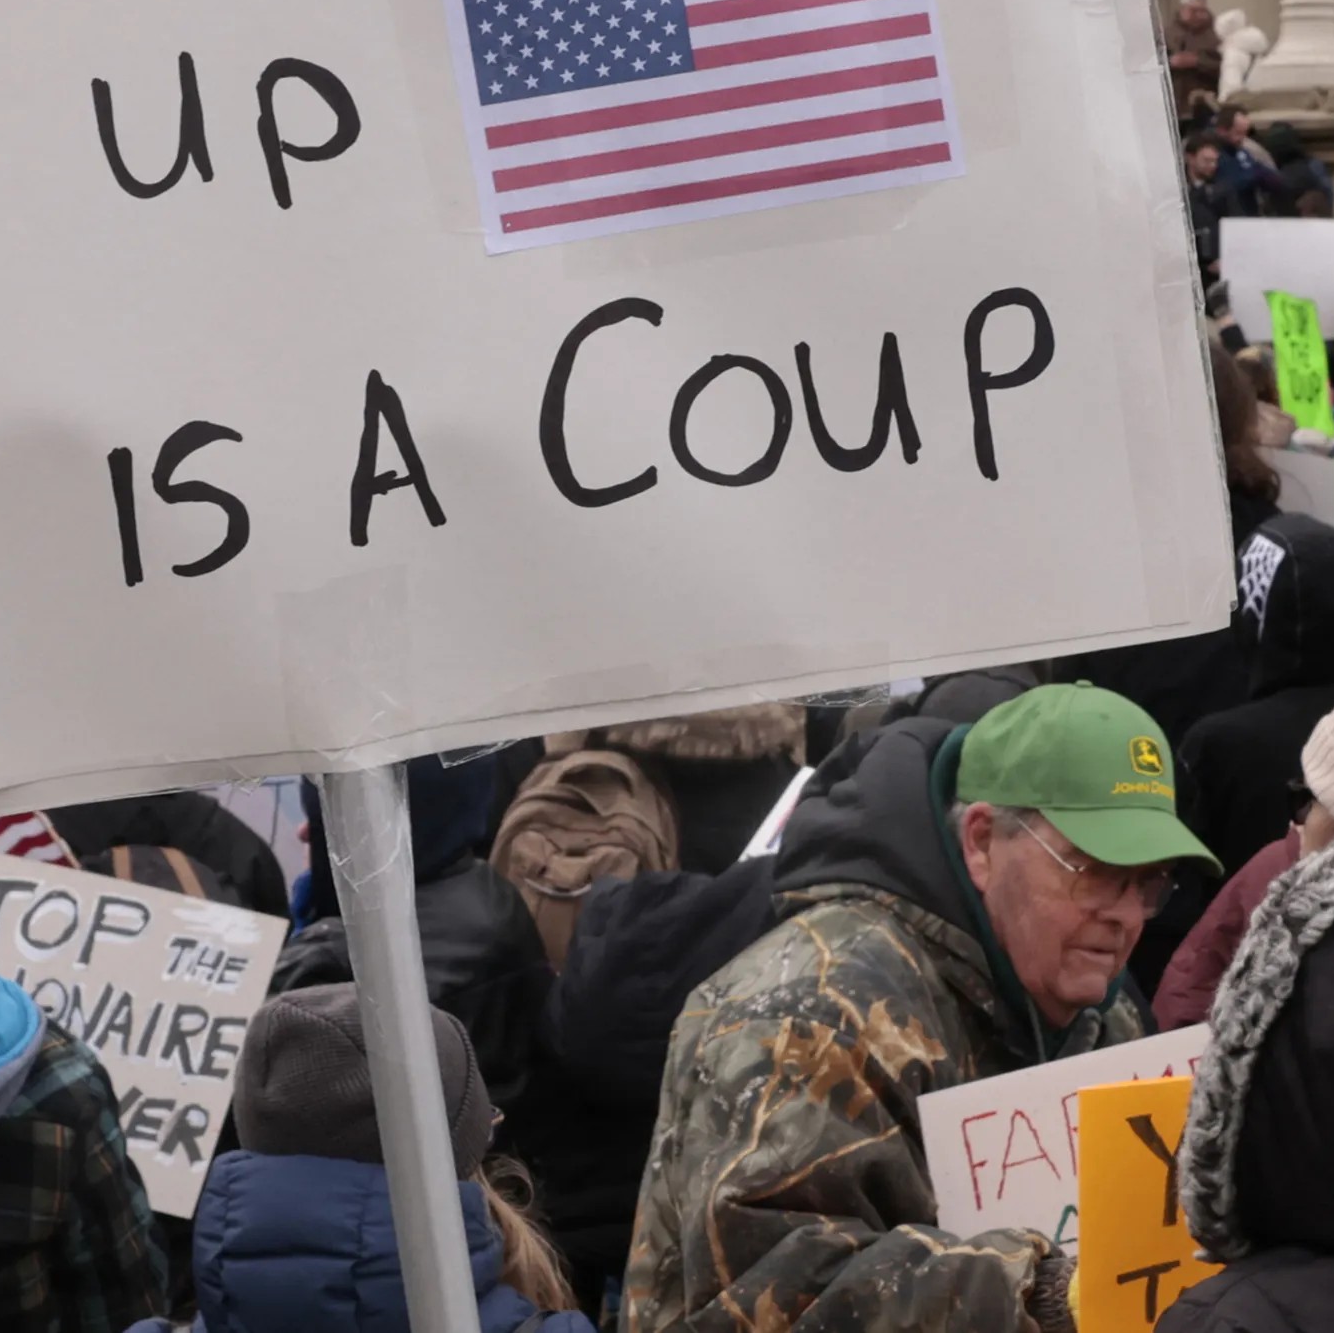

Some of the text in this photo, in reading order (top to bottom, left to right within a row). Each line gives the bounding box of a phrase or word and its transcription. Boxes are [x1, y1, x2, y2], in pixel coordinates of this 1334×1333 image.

[90, 50, 362, 211] UP
[106, 419, 251, 589] IS
[348, 368, 448, 548] A
[538, 286, 1056, 509] COUP
[1110, 780, 1151, 795] JOHN
[163, 936, 249, 985] THE
